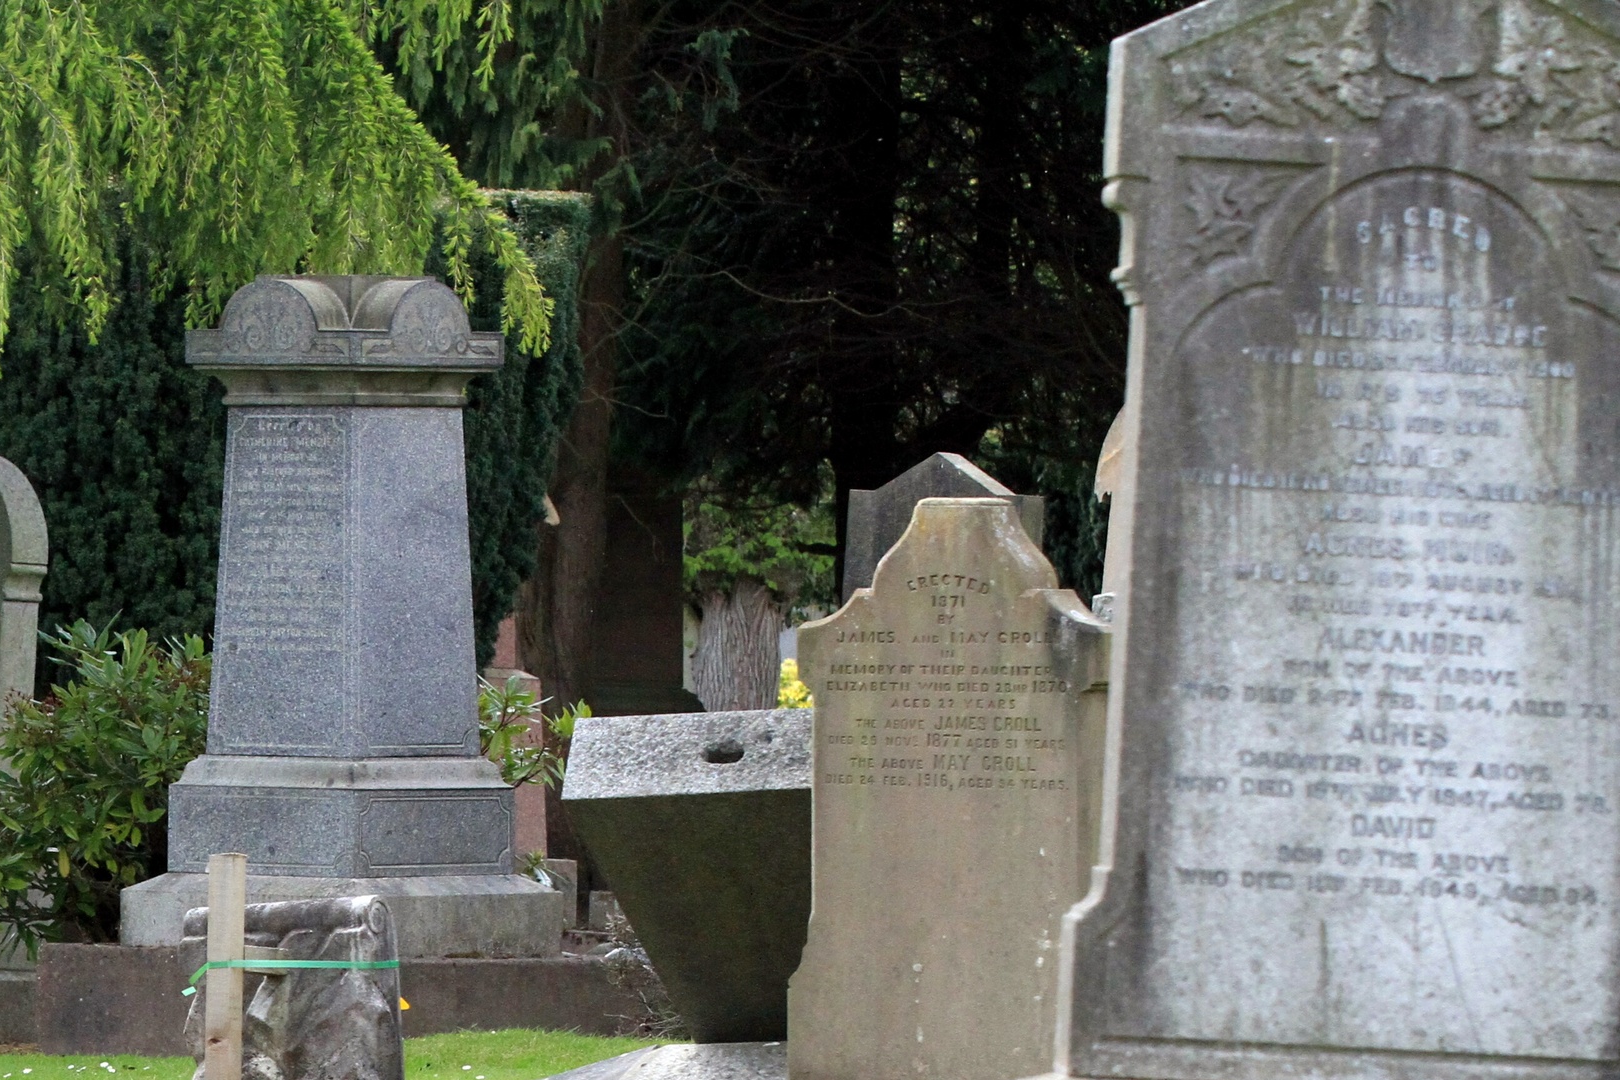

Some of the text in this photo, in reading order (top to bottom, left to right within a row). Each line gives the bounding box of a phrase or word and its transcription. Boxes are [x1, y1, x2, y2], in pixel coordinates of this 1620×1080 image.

[907, 574, 990, 595] ERECTED
[931, 595, 965, 607] 1871
[937, 614, 955, 625] BY
[912, 635, 939, 644] AND
[950, 631, 988, 644] MAY
[997, 631, 1050, 644] CROLL
[1318, 628, 1486, 657] ALEXANDER
[940, 649, 955, 658] IN
[831, 665, 1051, 677] MEMORY OF THEIR DAUGHTER
[1437, 667, 1519, 688] ABOVE
[826, 681, 1067, 693] ELIZABETH WHO DIED 1870
[891, 698, 1015, 709] AGED 22 YEARS
[856, 716, 1042, 732] THE ABOVE JAMES CROLL
[850, 754, 1036, 771] THE ABOVE MAY CROLL
[826, 774, 853, 784] DIED
[859, 774, 875, 785] 24
[958, 778, 992, 788] AGED
[1350, 814, 1437, 839] DAVID
